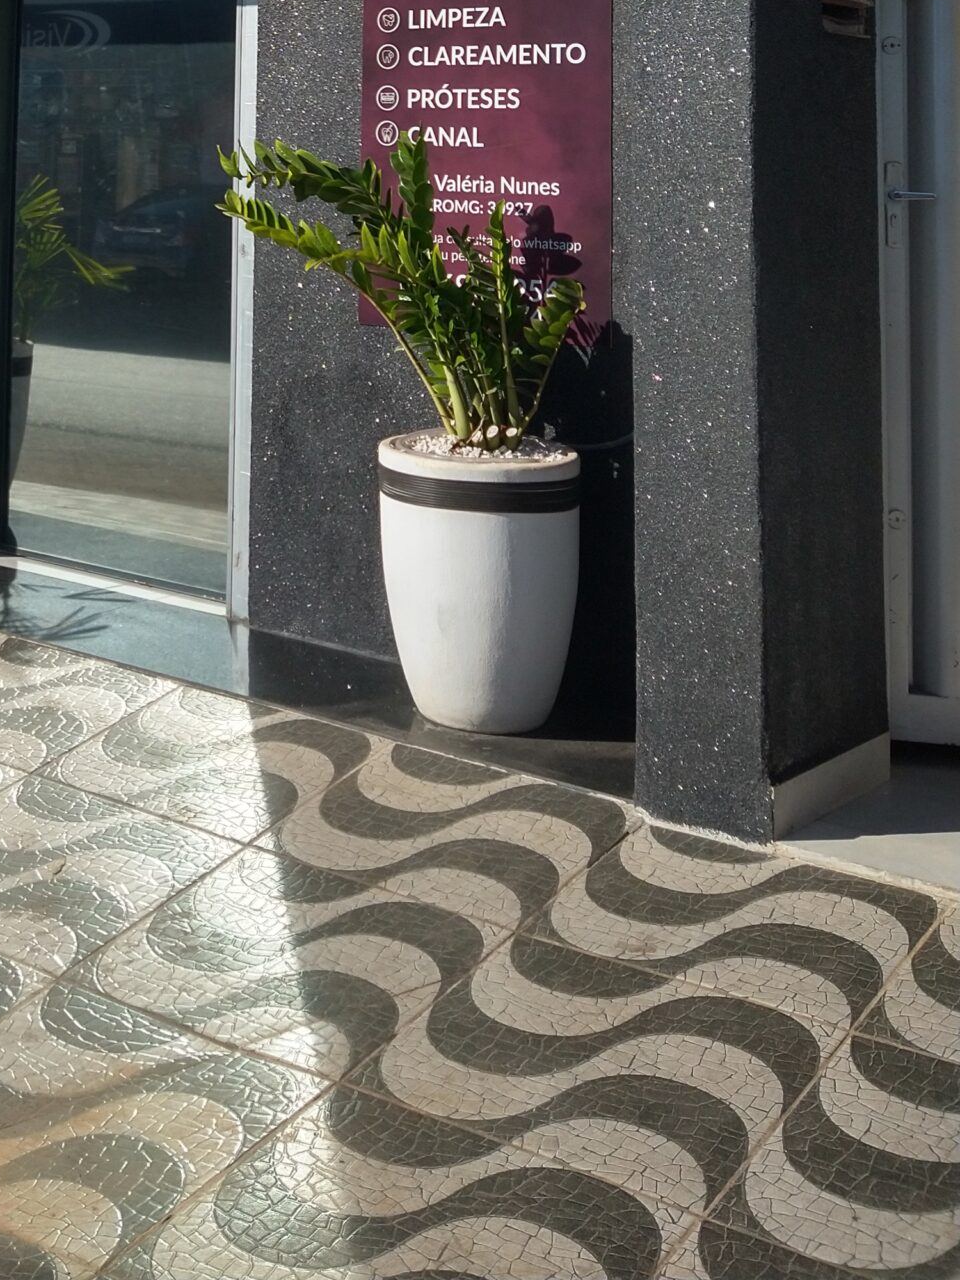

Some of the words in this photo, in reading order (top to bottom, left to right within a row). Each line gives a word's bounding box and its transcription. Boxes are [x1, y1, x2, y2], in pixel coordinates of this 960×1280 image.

[408, 7, 506, 30] LIMPEZA
[408, 43, 586, 67] CLAREAMENTO
[407, 83, 520, 109] PRÓTESES
[407, 126, 485, 148] CANAL
[434, 174, 495, 194] Valéria
[500, 176, 560, 195] Nunes
[429, 199, 484, 214] ROMG:
[487, 201, 533, 216] 3927
[524, 238, 582, 254] whatsapp
